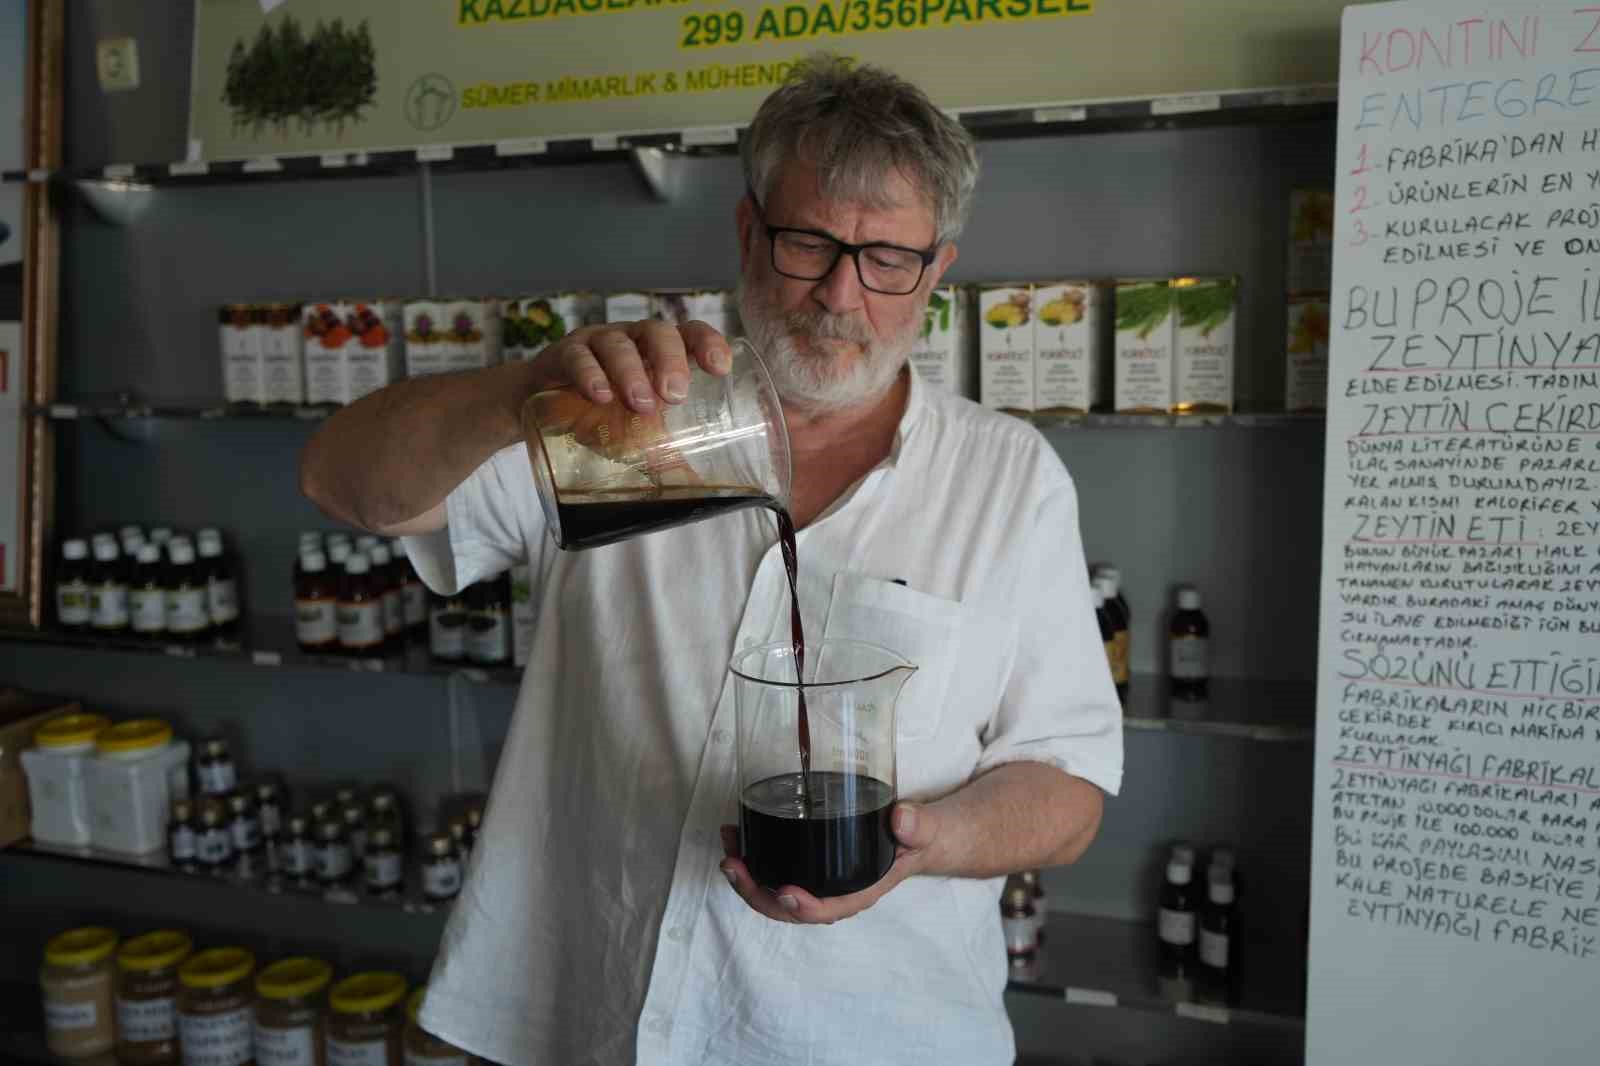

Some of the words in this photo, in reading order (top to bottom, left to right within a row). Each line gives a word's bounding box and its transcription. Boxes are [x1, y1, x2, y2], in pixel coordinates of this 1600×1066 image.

[682, 14, 744, 47] 299
[663, 71, 679, 92] &
[1389, 172, 1528, 206] ÜRÜNLERİN
[1541, 171, 1573, 194] EN
[1385, 211, 1532, 238] KURULACAK
[1383, 237, 1498, 264] EDİLMESİ
[1515, 239, 1545, 256] VE
[1343, 285, 1397, 331] BU
[1412, 269, 1559, 330] PROJE
[1345, 377, 1398, 398] ELDE
[1358, 396, 1470, 437] ZEYTİN
[1351, 510, 1456, 542] ZEYTİN
[1341, 683, 1509, 717] FABRİKALARIN
[1335, 872, 1392, 897] KALE
